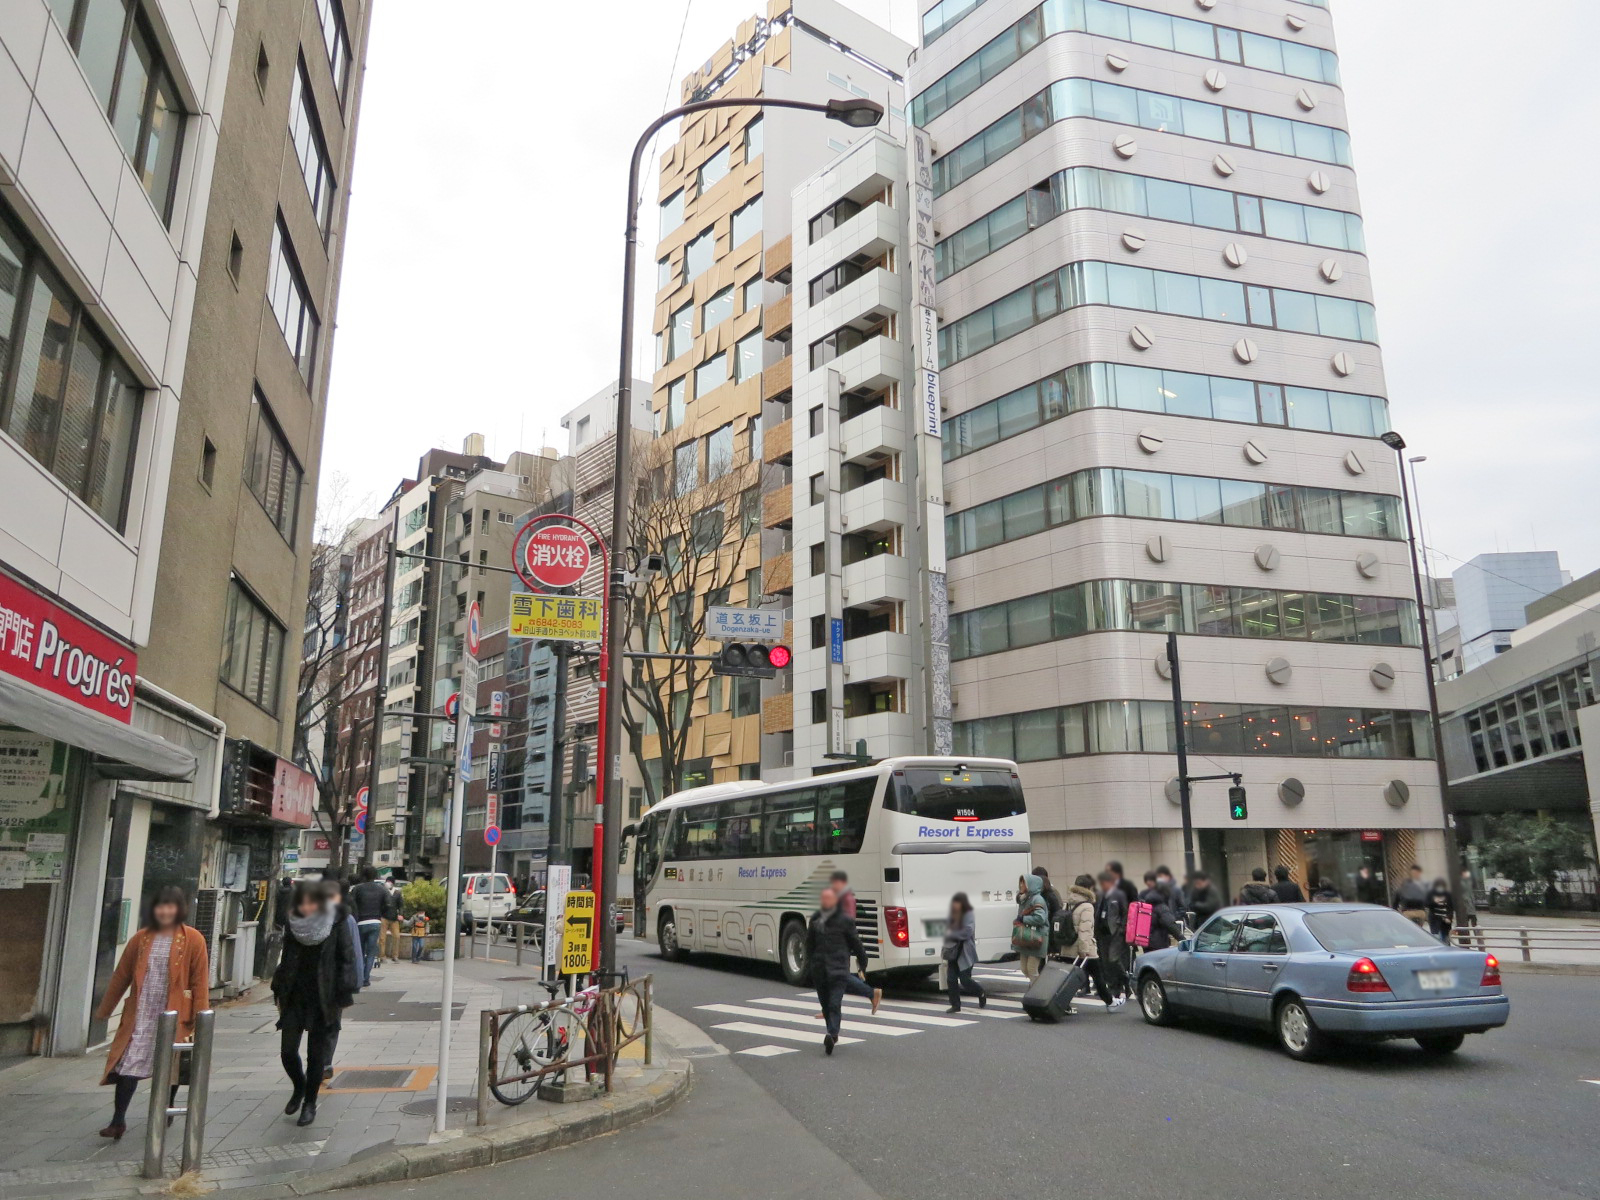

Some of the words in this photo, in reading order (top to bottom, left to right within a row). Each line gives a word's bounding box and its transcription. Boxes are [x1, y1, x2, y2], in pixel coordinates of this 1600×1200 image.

[927, 373, 938, 434] blueprint
[537, 533, 551, 541] FIRE
[552, 534, 580, 542] HYDRANT
[532, 543, 586, 569] 消火栓
[513, 596, 598, 621] 雪下歯科
[715, 611, 777, 627] 道玄坂上
[721, 624, 771, 634] Dogenzaka-ue
[35, 619, 132, 708] Progrés
[918, 825, 960, 837] Resort
[966, 825, 1014, 839] Express
[738, 866, 758, 878] Resort
[760, 865, 787, 879] Express
[566, 896, 594, 909] 時間貸
[981, 889, 1018, 902] 富士急
